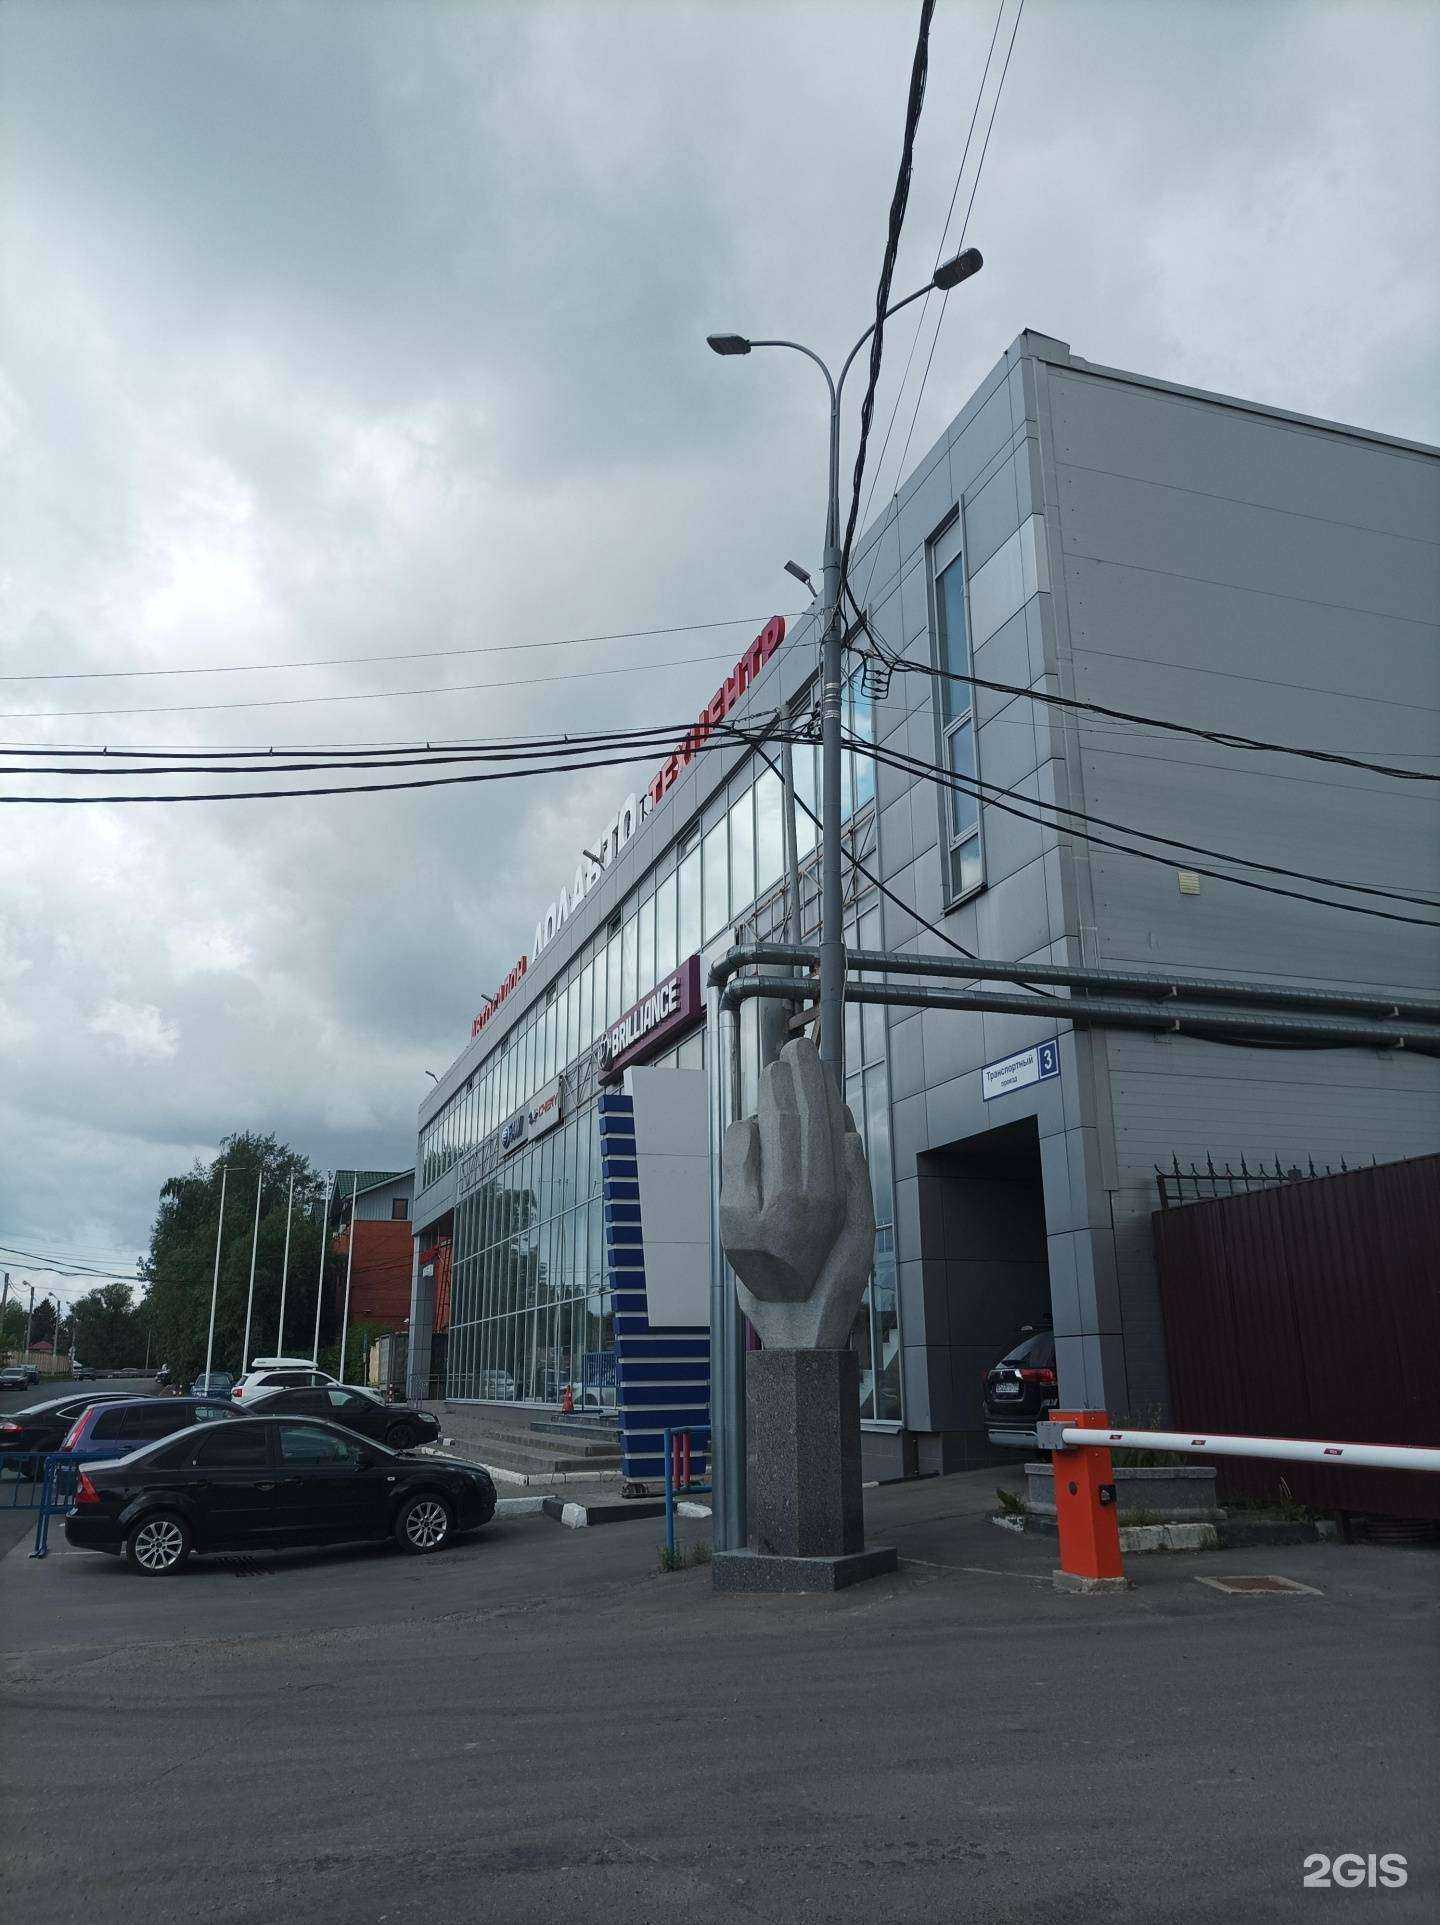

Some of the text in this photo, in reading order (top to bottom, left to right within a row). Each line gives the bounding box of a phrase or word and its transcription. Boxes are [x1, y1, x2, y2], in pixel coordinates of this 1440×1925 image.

[612, 977, 679, 1058] BRILLIANCE
[986, 1055, 1034, 1082] Транспортный
[1043, 1049, 1053, 1070] 3
